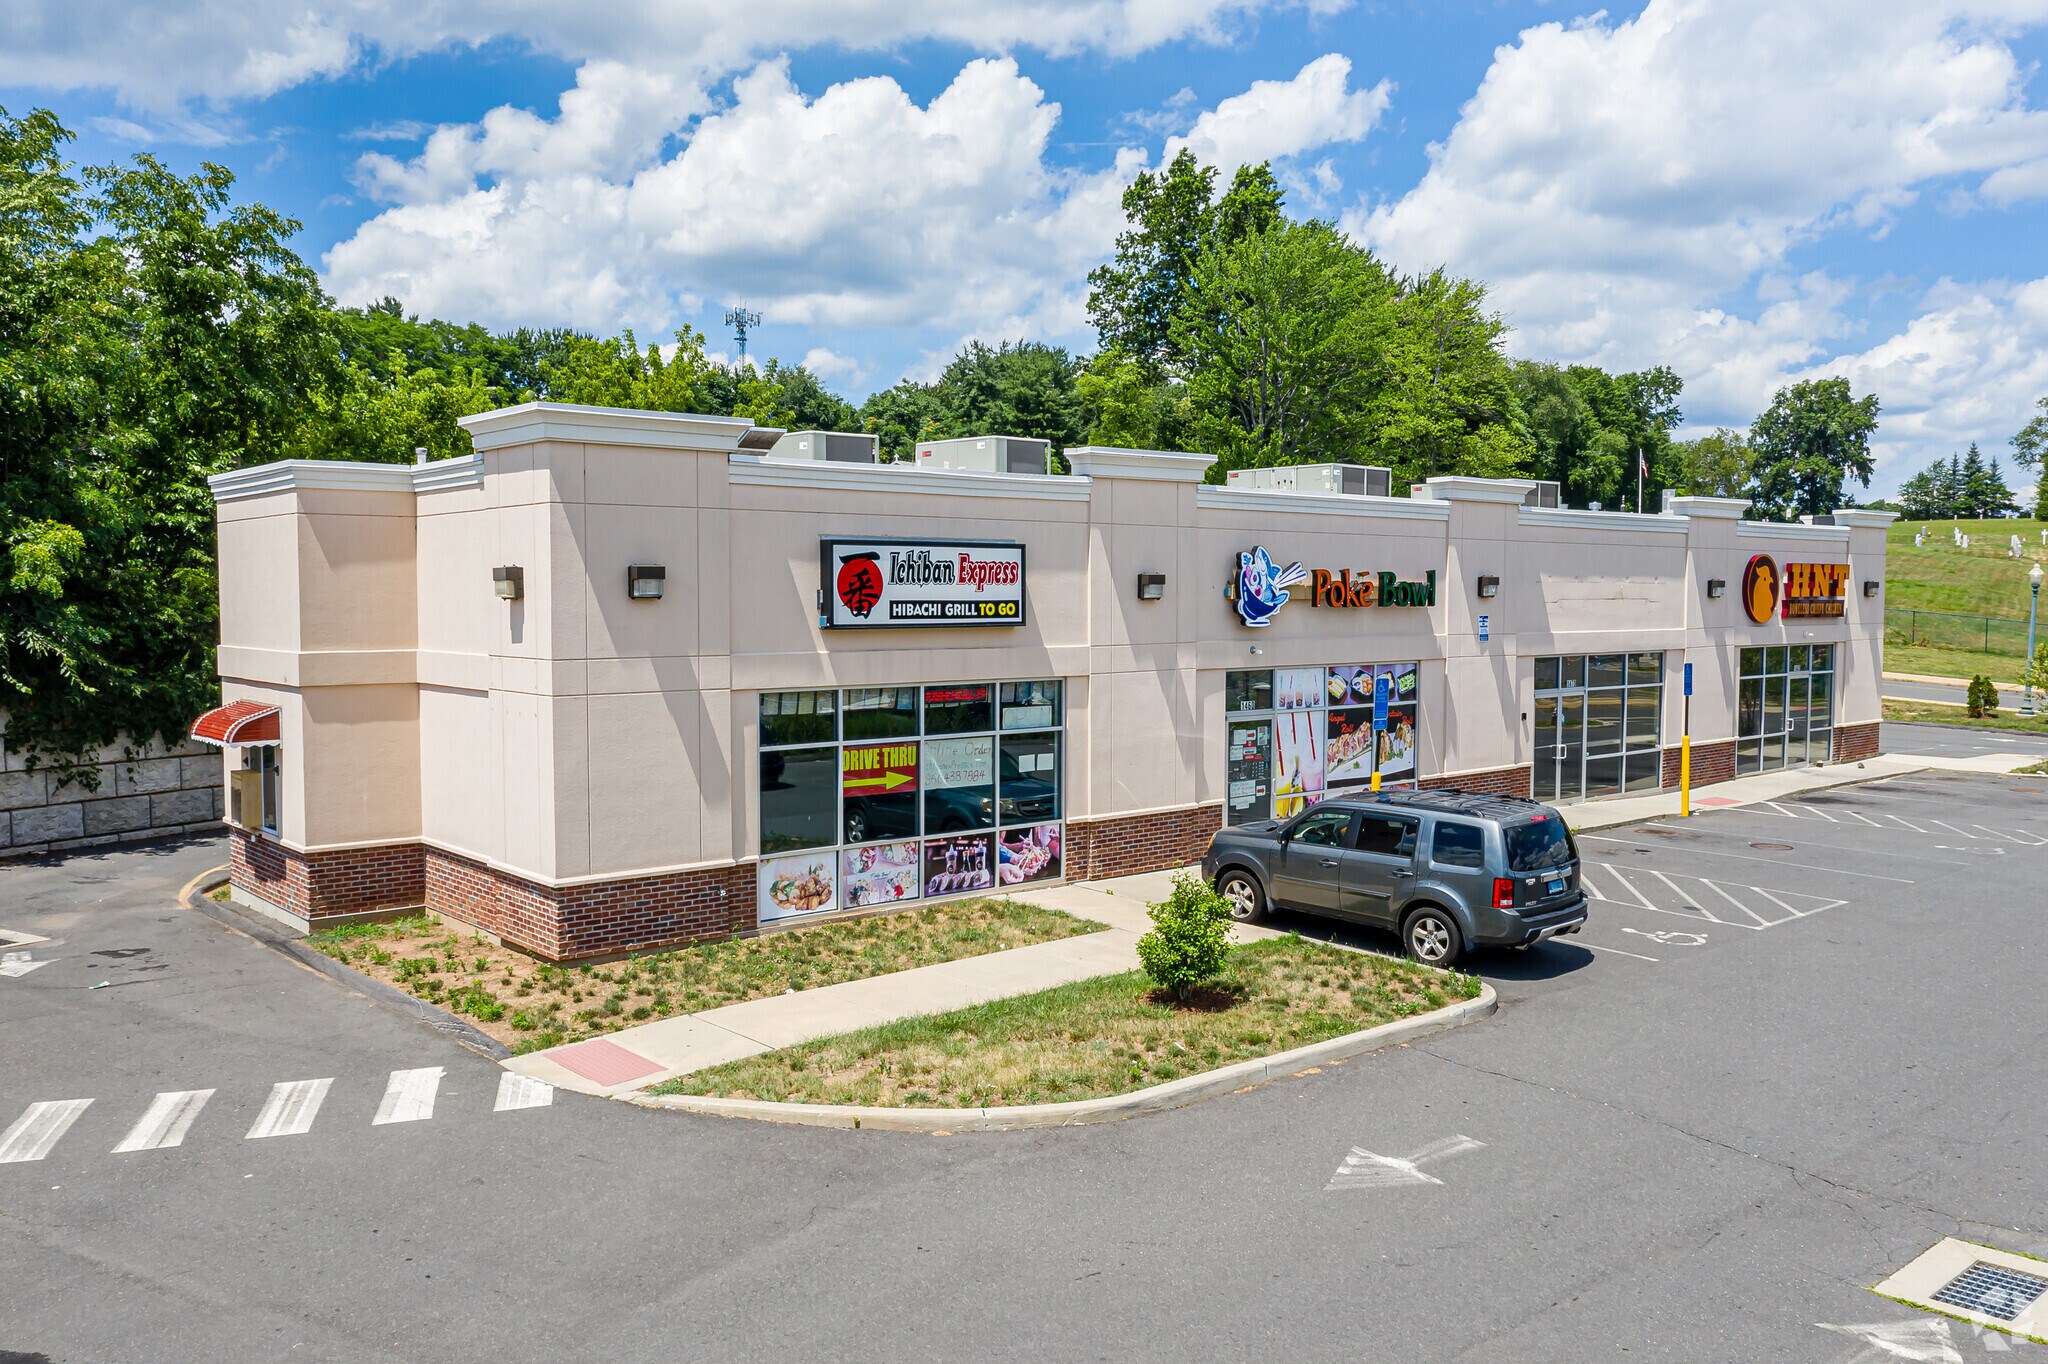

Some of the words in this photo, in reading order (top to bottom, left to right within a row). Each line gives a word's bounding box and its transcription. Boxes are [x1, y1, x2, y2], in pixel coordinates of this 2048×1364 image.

[888, 549, 955, 587] Ichiban
[957, 553, 1019, 592] Express
[1786, 563, 1849, 597] HNT
[1377, 569, 1437, 608] Bowl
[892, 603, 942, 616] HIBACHI
[945, 603, 978, 616] GRILL
[979, 603, 994, 616] TO
[998, 602, 1016, 616] GO
[843, 747, 880, 772] DRIVE
[883, 745, 917, 768] THRU
